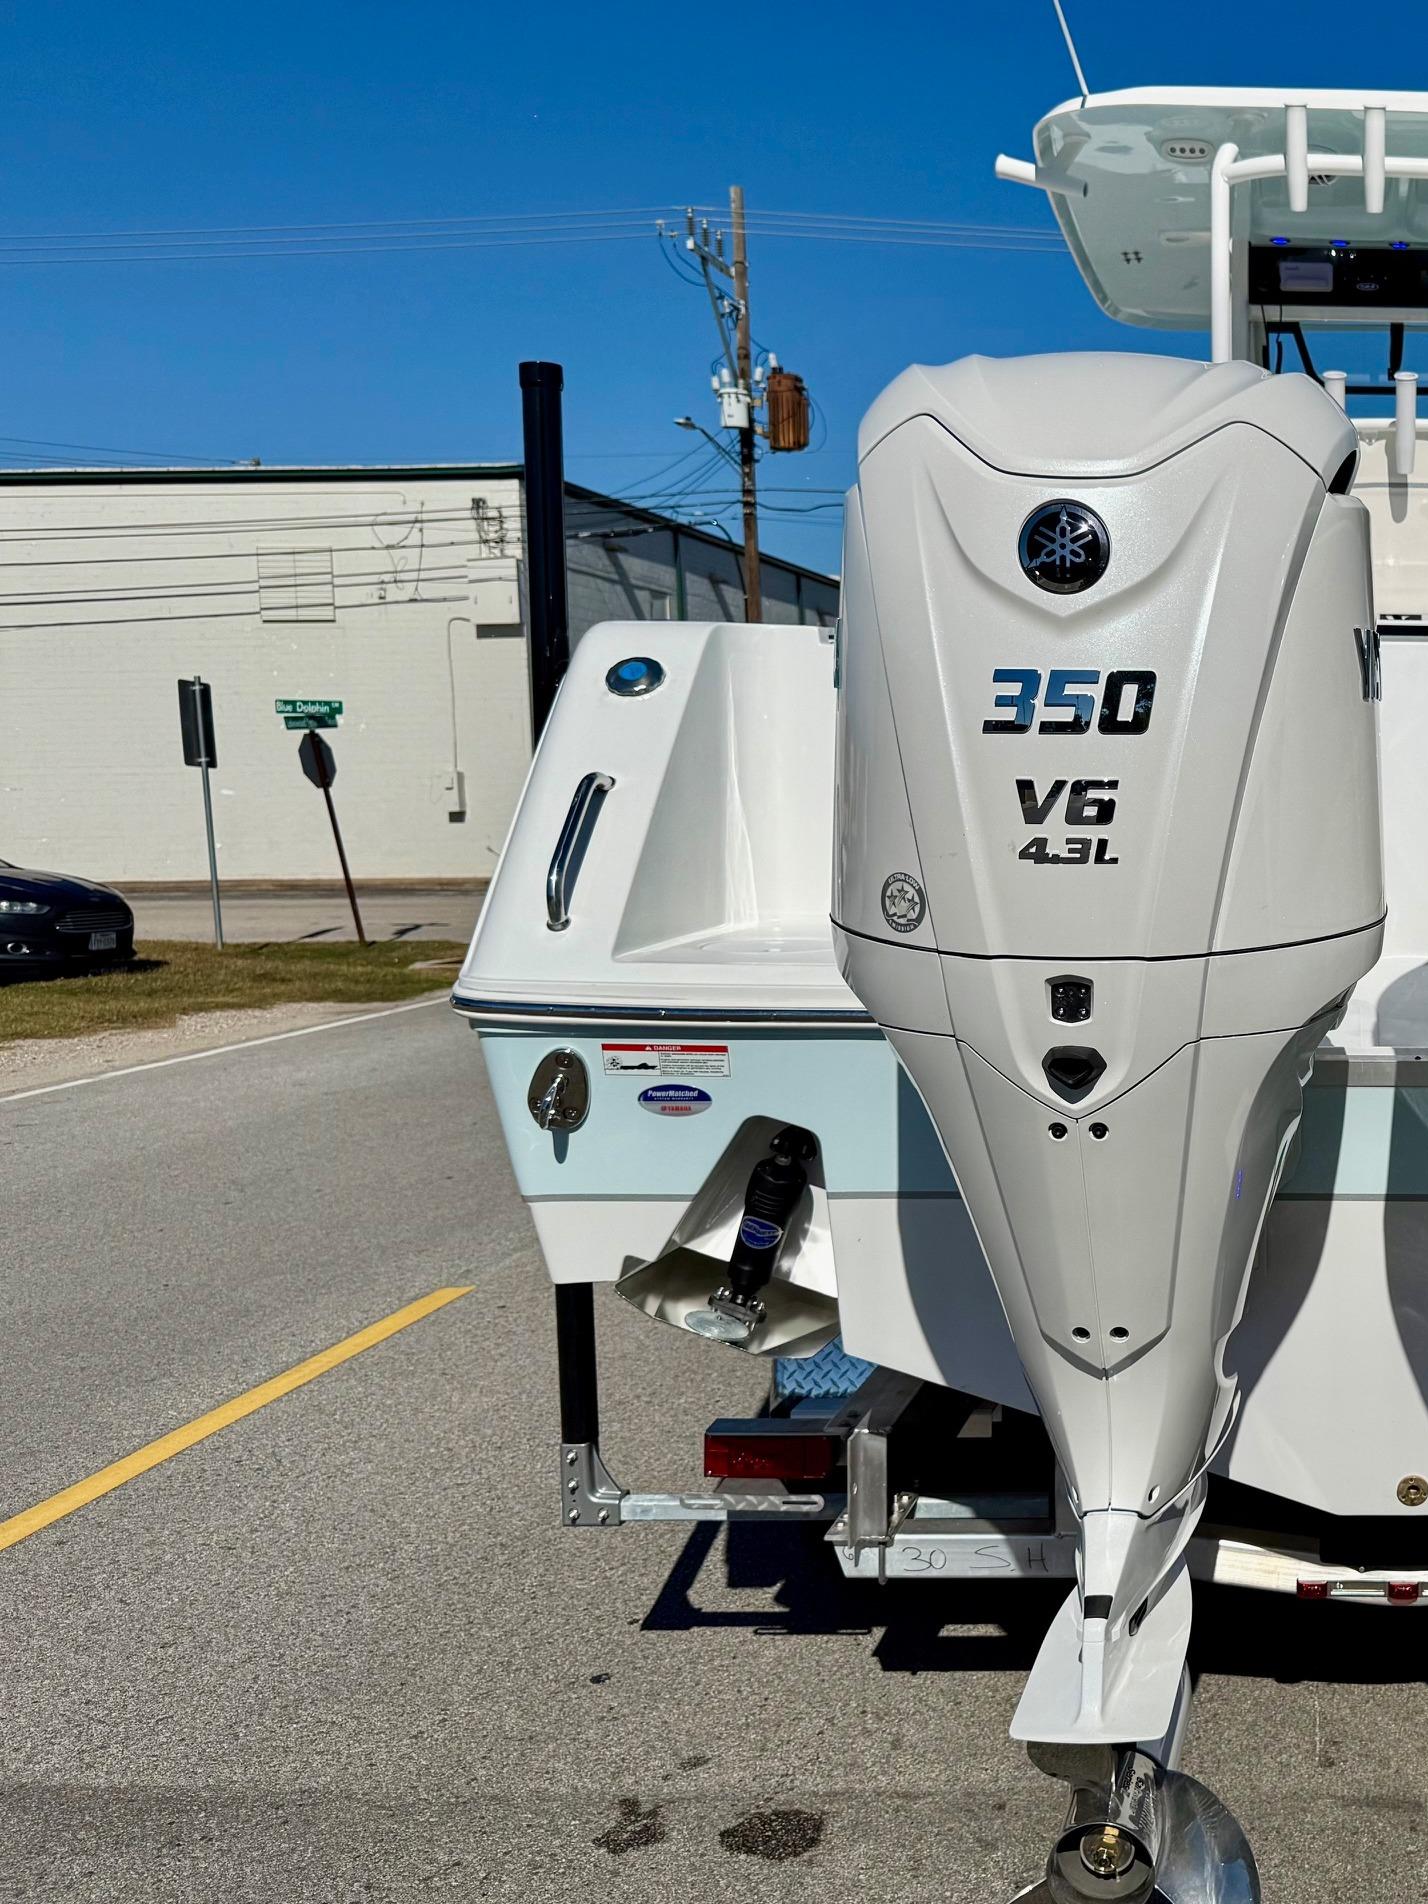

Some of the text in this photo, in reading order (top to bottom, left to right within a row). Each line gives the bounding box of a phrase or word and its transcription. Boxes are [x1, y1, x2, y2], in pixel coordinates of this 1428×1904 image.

[276, 701, 293, 712] Blue
[296, 701, 330, 713] Dolphin
[982, 668, 1157, 735] 350
[1015, 779, 1119, 826] V6
[1018, 837, 1119, 864] 4.3L
[902, 1546, 947, 1572] 30
